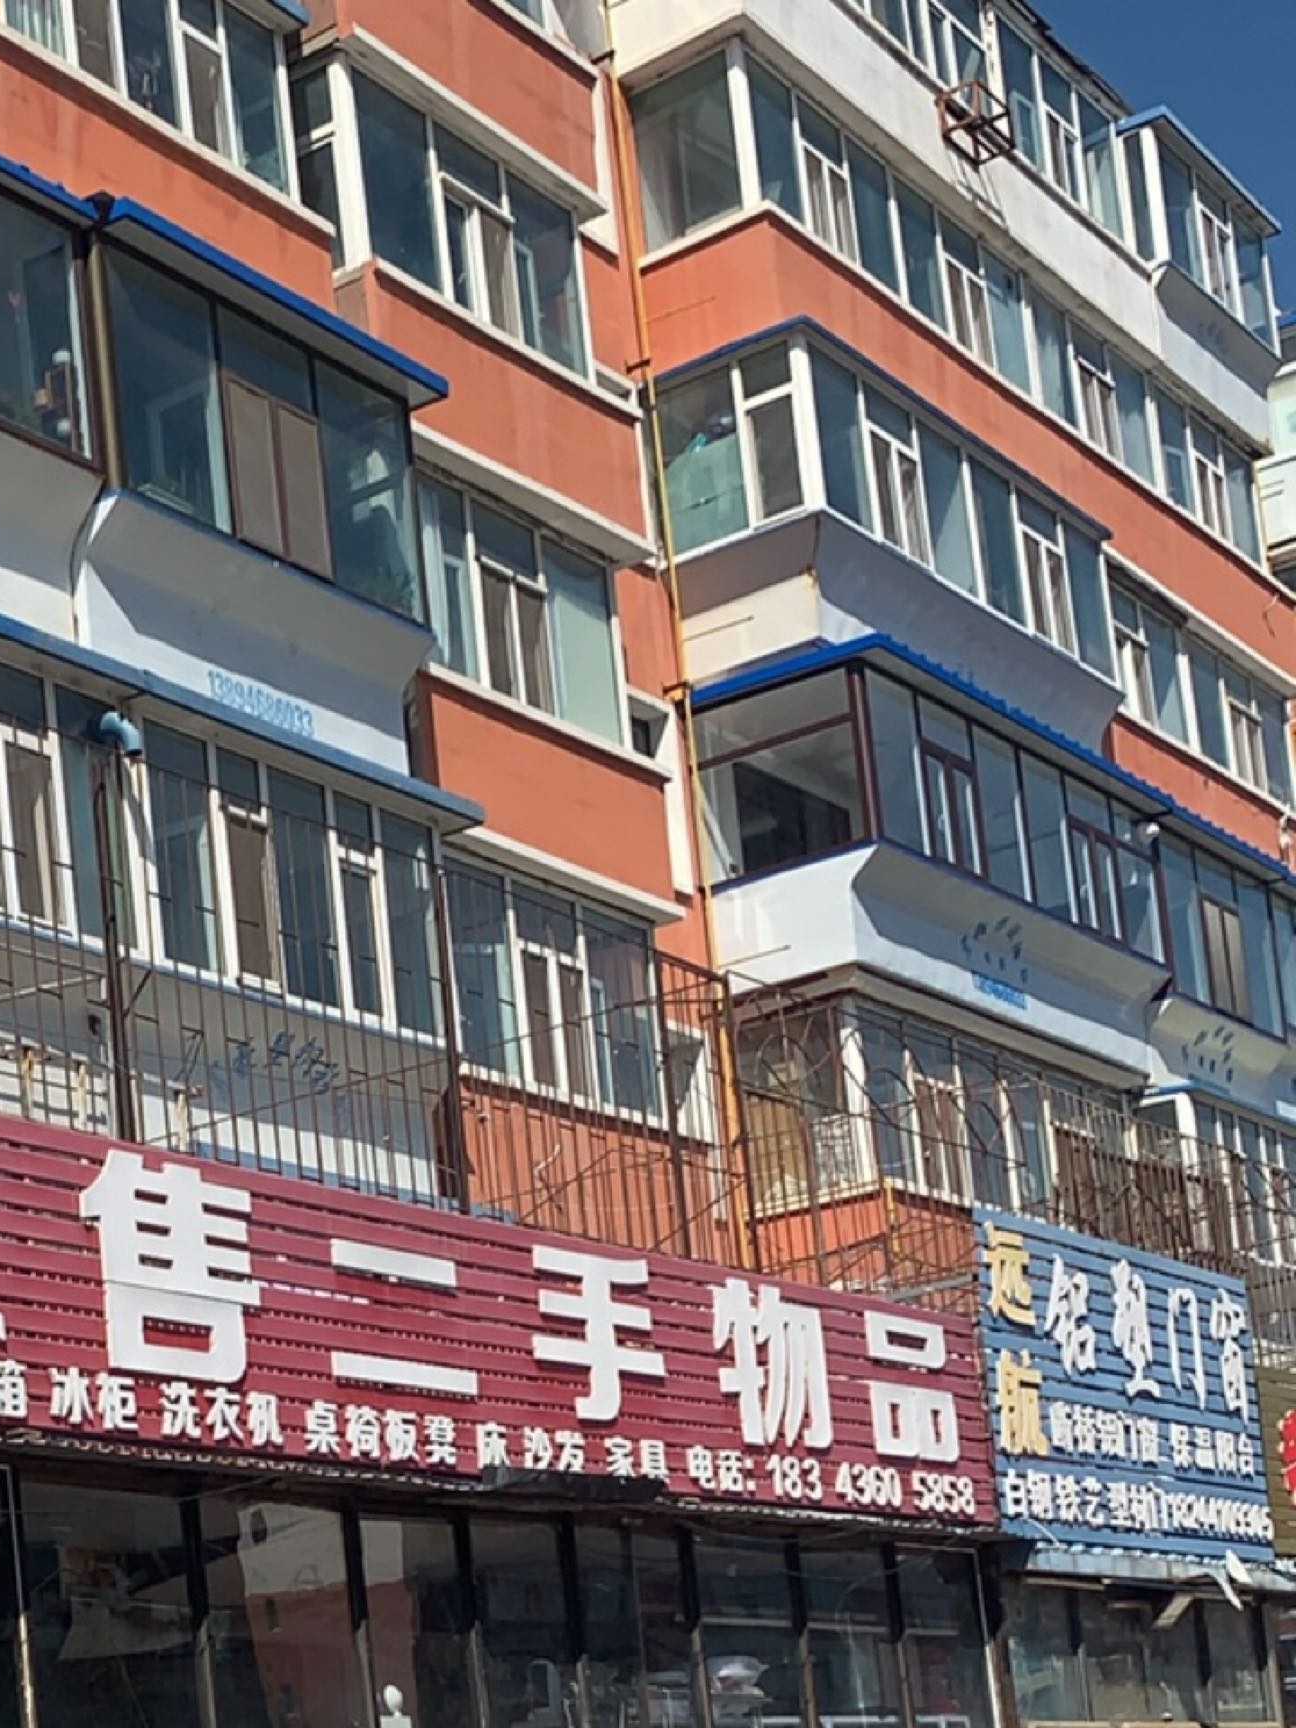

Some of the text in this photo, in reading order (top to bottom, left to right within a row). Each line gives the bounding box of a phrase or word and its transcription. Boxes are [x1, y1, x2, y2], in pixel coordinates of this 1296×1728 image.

[50, 1367, 139, 1431] 冰柜
[160, 1381, 284, 1447] 洗衣机
[304, 1399, 457, 1465] 桌椅板凳
[475, 1421, 512, 1469] 床
[522, 1425, 586, 1474] 沙发
[604, 1436, 670, 1483] 家具
[983, 1220, 1049, 1457] 远航
